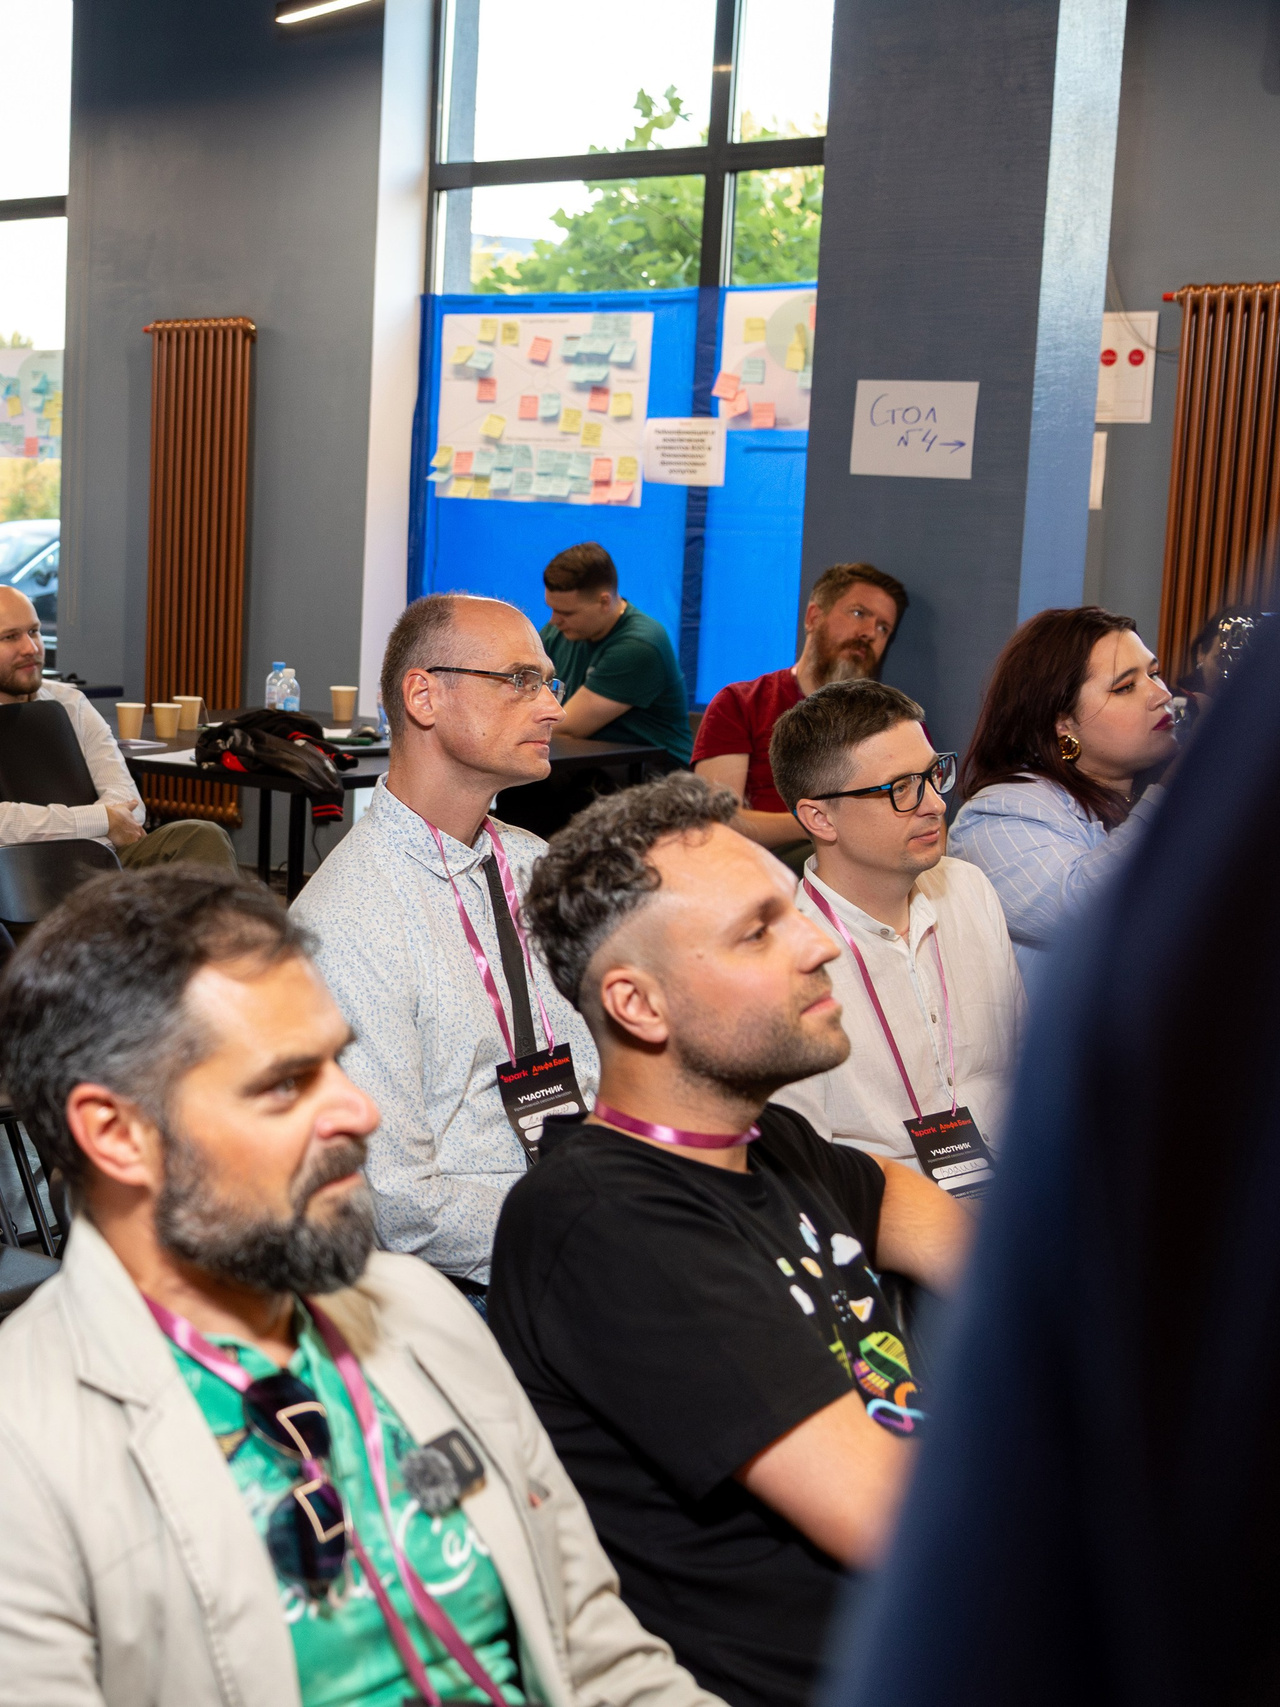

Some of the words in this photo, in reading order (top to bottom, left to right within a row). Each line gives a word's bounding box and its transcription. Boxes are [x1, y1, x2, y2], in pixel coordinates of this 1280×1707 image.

[871, 393, 937, 427] Стол
[517, 1084, 564, 1104] УЧАСТНИК
[930, 1142, 972, 1157] УЧАСТНИК
